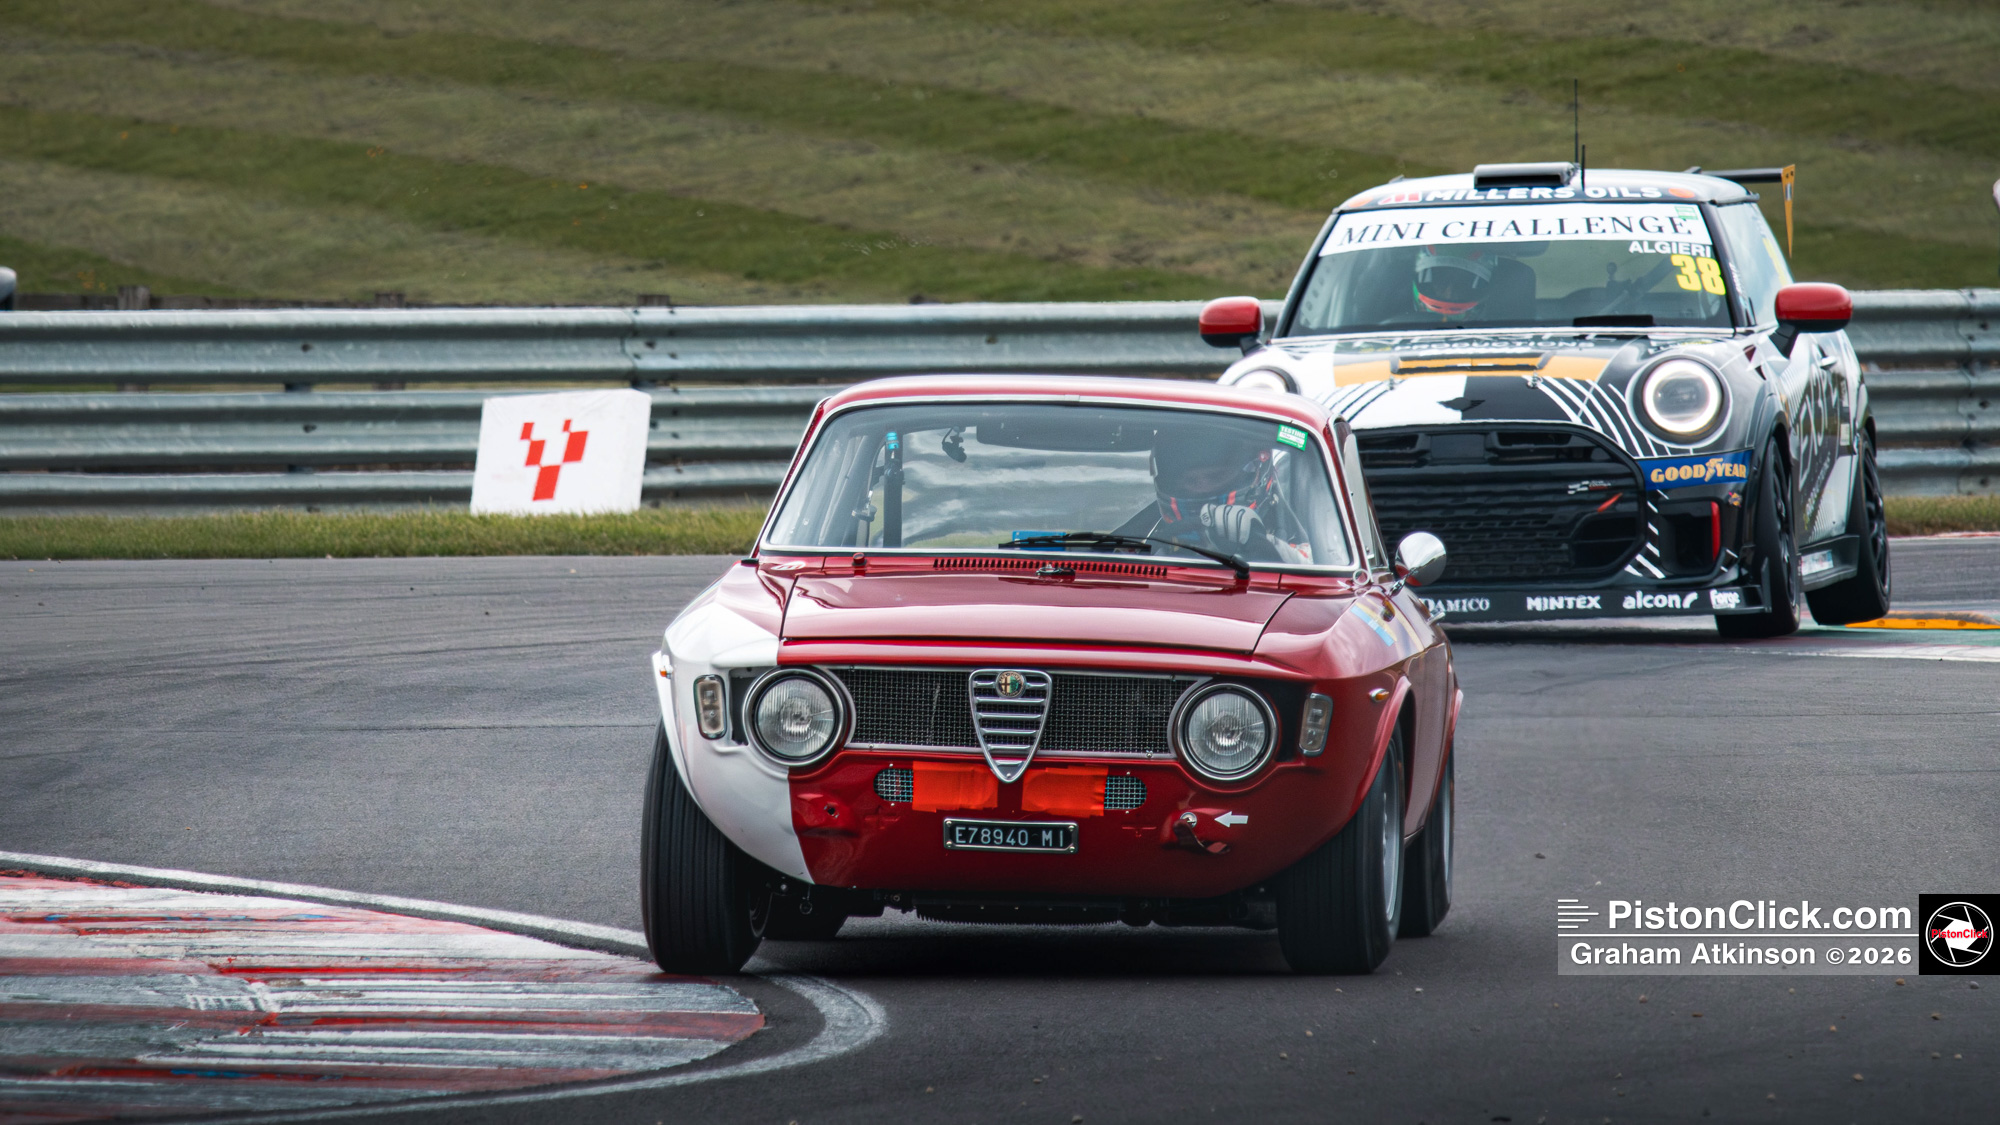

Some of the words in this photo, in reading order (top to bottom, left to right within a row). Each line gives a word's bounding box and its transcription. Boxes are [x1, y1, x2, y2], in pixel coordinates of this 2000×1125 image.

[1425, 187, 1575, 202] MILLERS
[1584, 187, 1663, 199] OILS
[1338, 222, 1429, 246] MINI
[1442, 216, 1692, 239] CHALLENGE
[1629, 241, 1712, 258] ALGIERI
[1671, 254, 1726, 295] 38
[1650, 460, 1747, 483] GOODYEAR
[1526, 595, 1602, 611] MINTEX
[1622, 590, 1681, 609] alcon
[955, 826, 1029, 846] E78940
